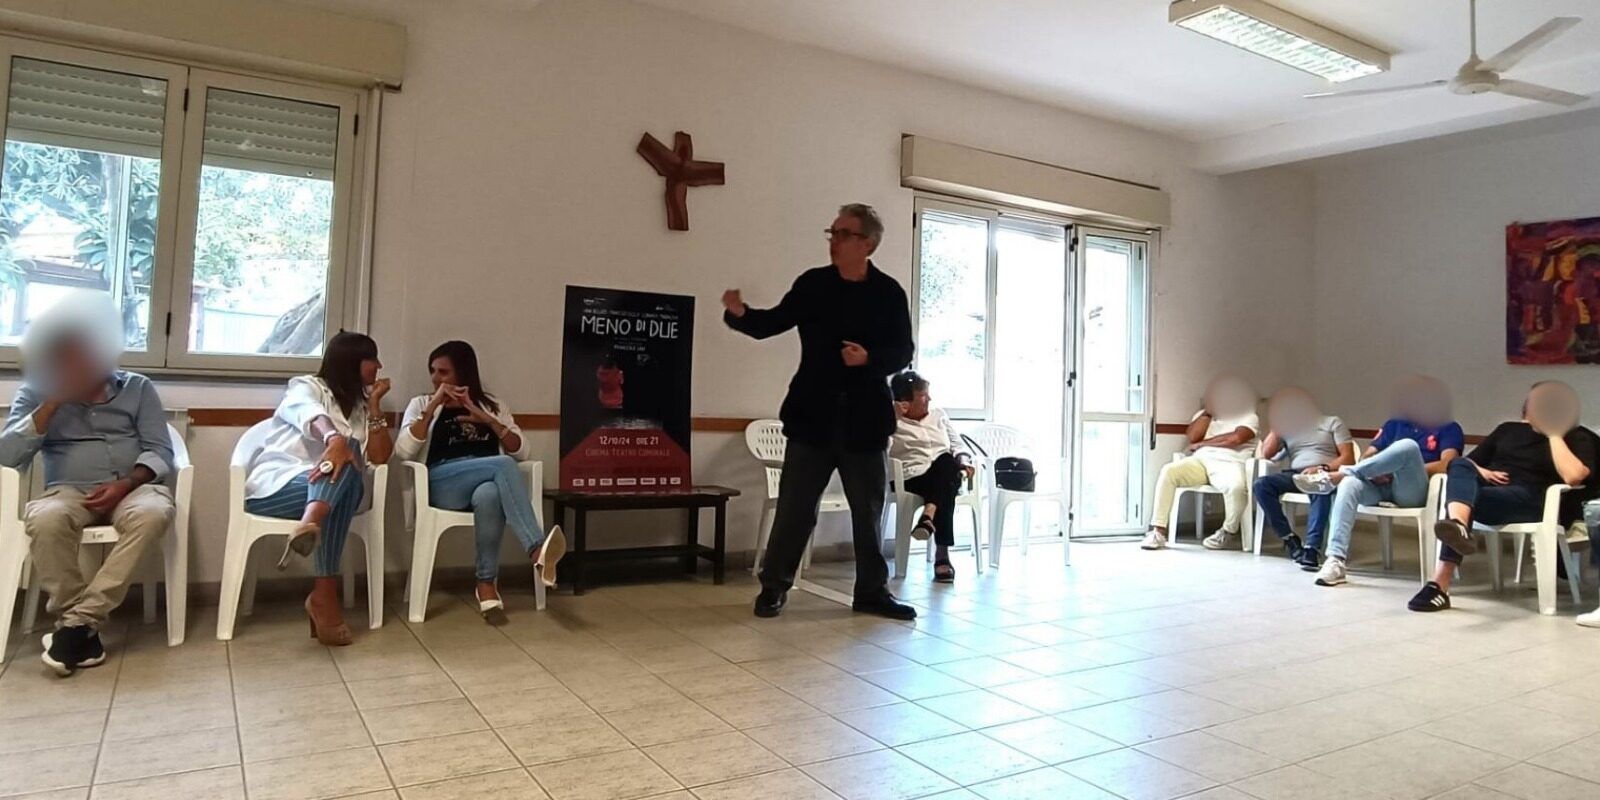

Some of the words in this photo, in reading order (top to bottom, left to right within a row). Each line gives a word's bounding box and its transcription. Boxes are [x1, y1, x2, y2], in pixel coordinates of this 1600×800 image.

[581, 315, 631, 335] MENO
[635, 319, 646, 332] DI
[649, 320, 678, 339] DUE
[600, 435, 630, 446] 12/10/24
[650, 436, 659, 446] 21
